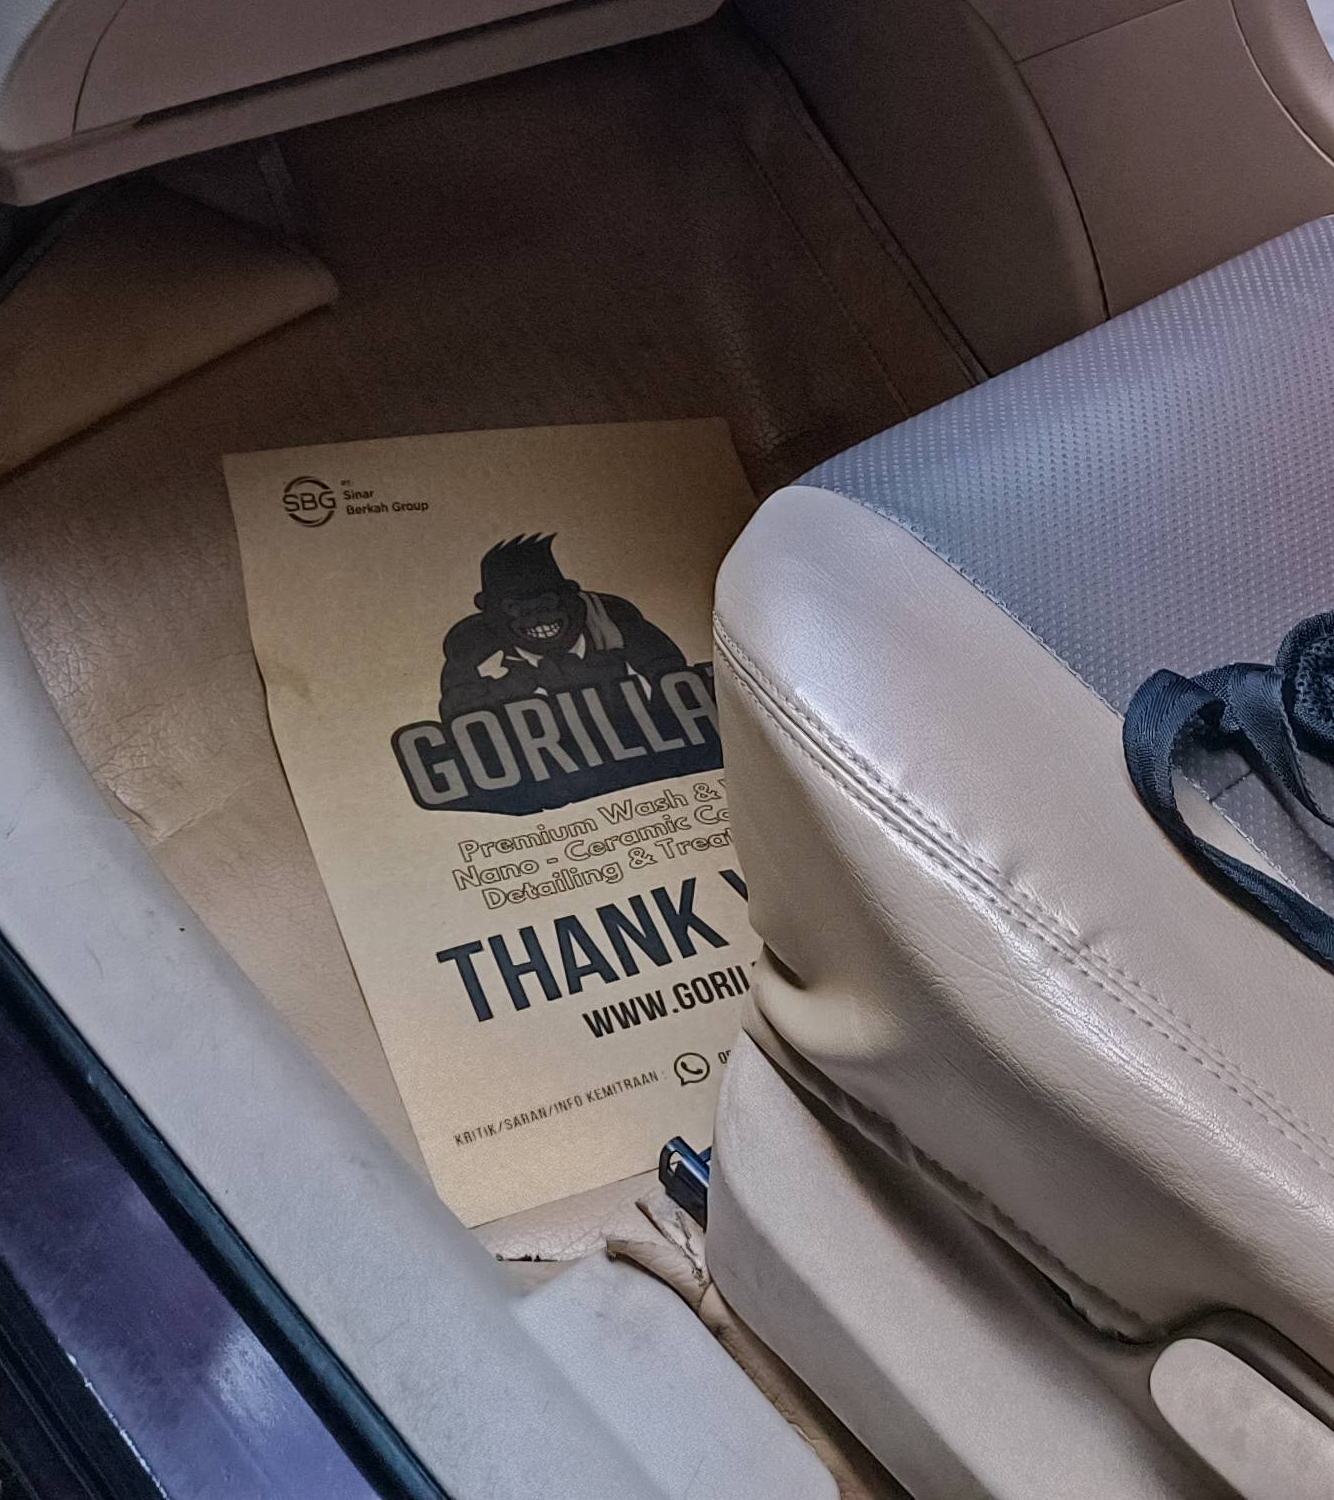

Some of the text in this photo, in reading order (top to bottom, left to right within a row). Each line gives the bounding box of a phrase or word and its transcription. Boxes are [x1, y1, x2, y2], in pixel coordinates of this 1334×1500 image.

[282, 491, 336, 512] SBG
[343, 490, 374, 500] Sinar
[346, 502, 429, 515] Berkah Group
[398, 671, 720, 805] GORILLA
[452, 859, 539, 891] Nano
[564, 814, 691, 862] Ceramic
[458, 782, 723, 863] Premium Wash &
[482, 861, 624, 910] Detailing
[628, 847, 658, 870] &
[435, 876, 730, 1023] THANK
[453, 1094, 583, 1147] KRITIK/SARAN/INFO
[585, 1070, 659, 1104] KEMITRAAN
